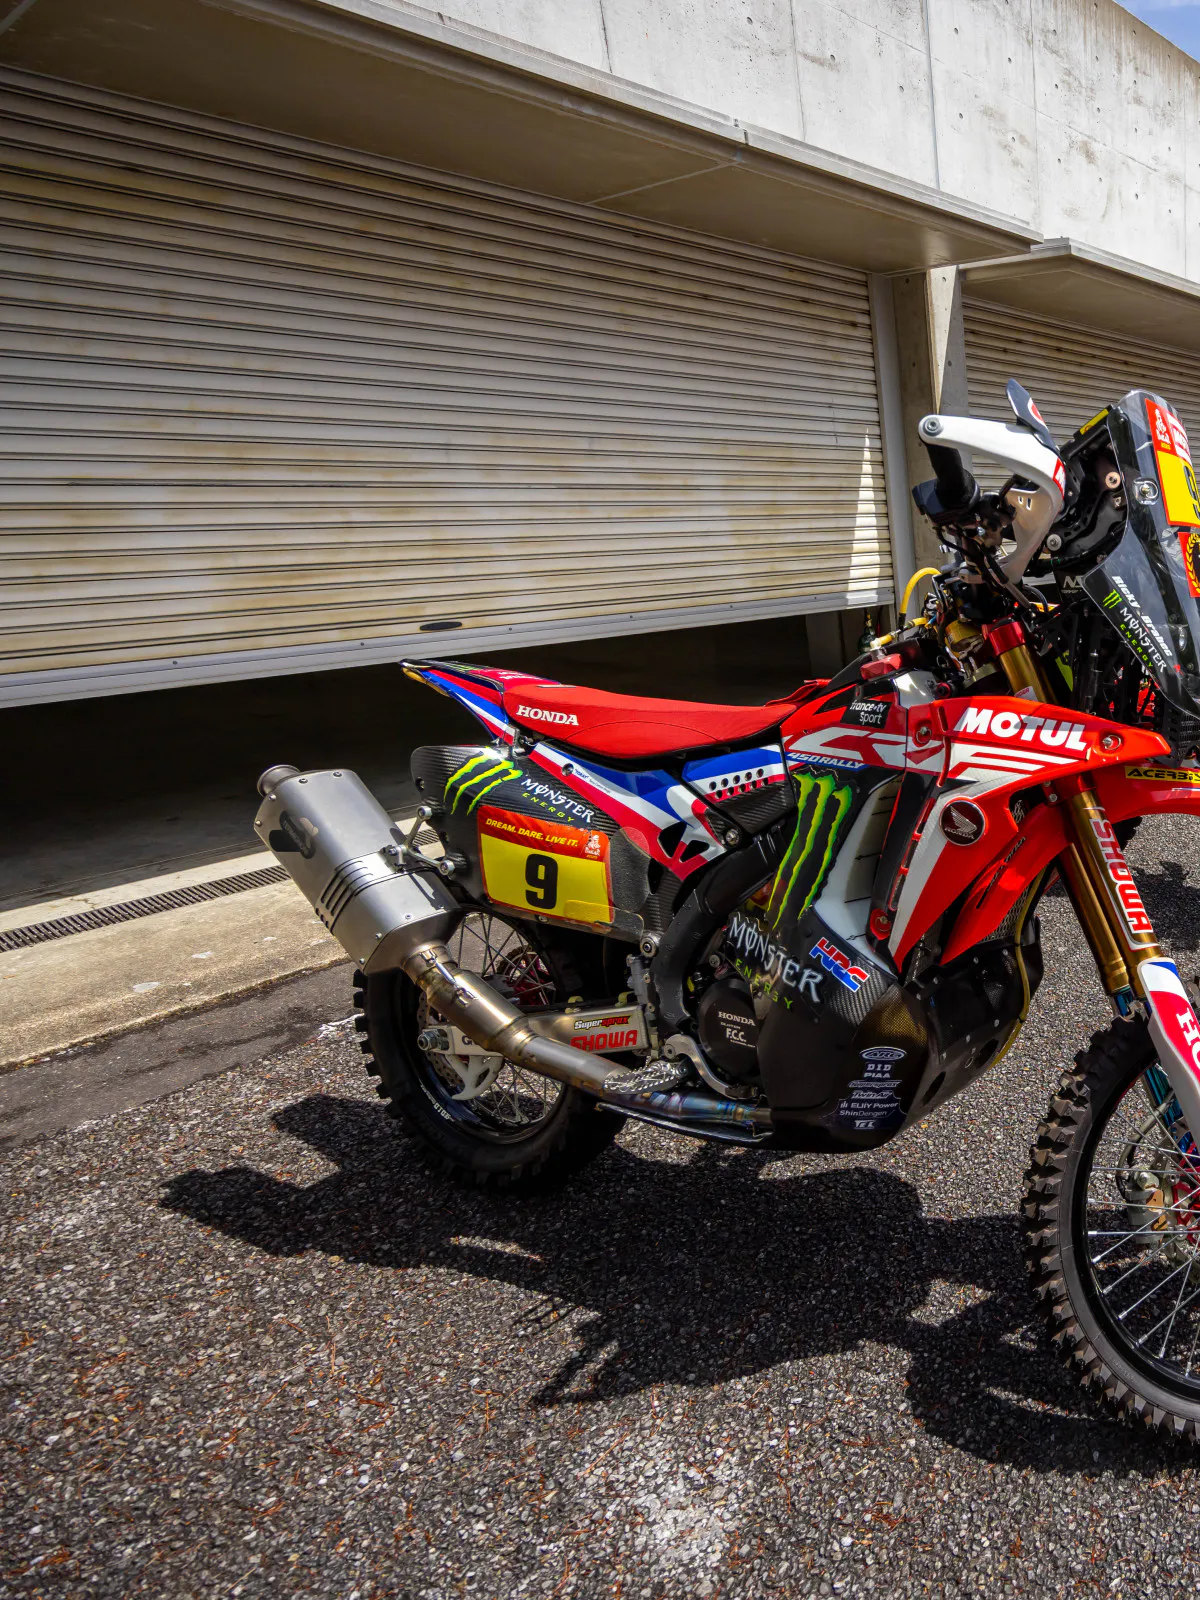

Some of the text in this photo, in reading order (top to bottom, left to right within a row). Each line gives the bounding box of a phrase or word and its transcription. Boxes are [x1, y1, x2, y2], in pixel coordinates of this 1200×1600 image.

[1111, 575, 1173, 657] Ricky Brabec
[1120, 623, 1153, 667] ENERGY
[516, 704, 579, 726] HONDA
[859, 711, 883, 726] sport
[954, 707, 1087, 752] MOTUL
[786, 751, 866, 770] 450RALLY
[522, 792, 575, 822] ENERGY
[485, 818, 578, 847] DREAM. DARE. LIVE IT.
[944, 827, 975, 840] HONDA
[524, 853, 559, 910] 9
[1089, 818, 1154, 934] SHOWA
[808, 936, 871, 993] HRC
[574, 1015, 631, 1030] Supersprox
[717, 1011, 756, 1026] HONDA
[570, 1029, 638, 1051] SHOWA
